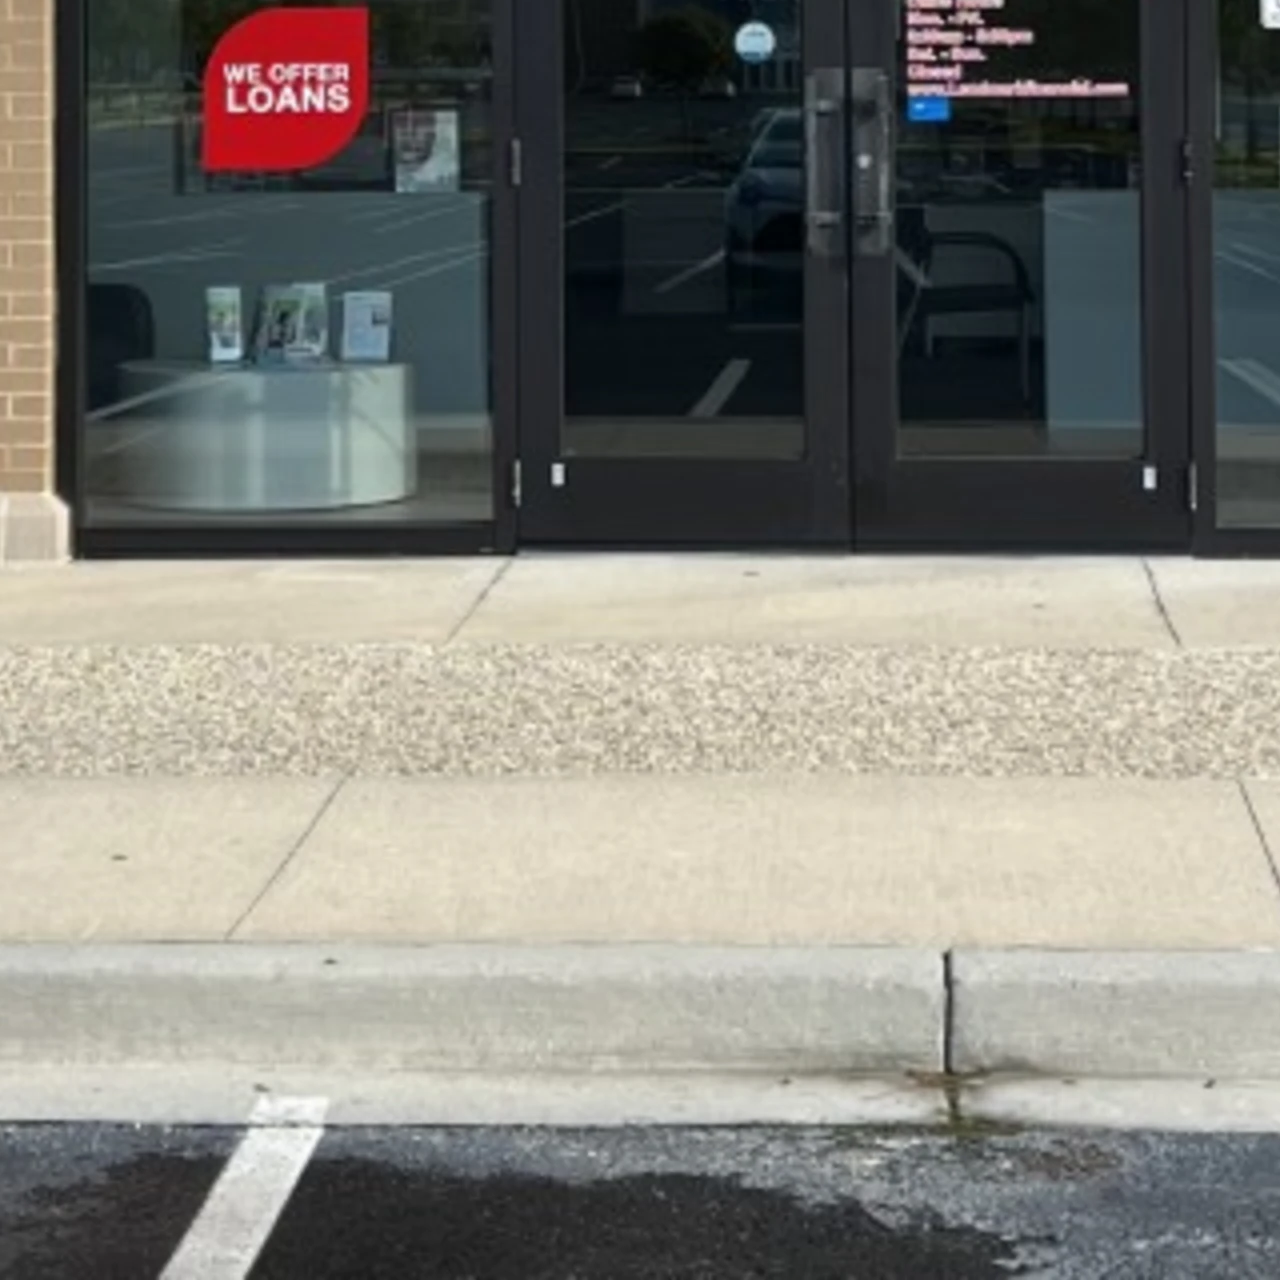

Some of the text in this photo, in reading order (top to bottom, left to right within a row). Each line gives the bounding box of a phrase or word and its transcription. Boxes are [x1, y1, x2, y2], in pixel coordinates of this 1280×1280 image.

[223, 63, 350, 85] WE OFFER
[226, 85, 351, 113] LOANS
